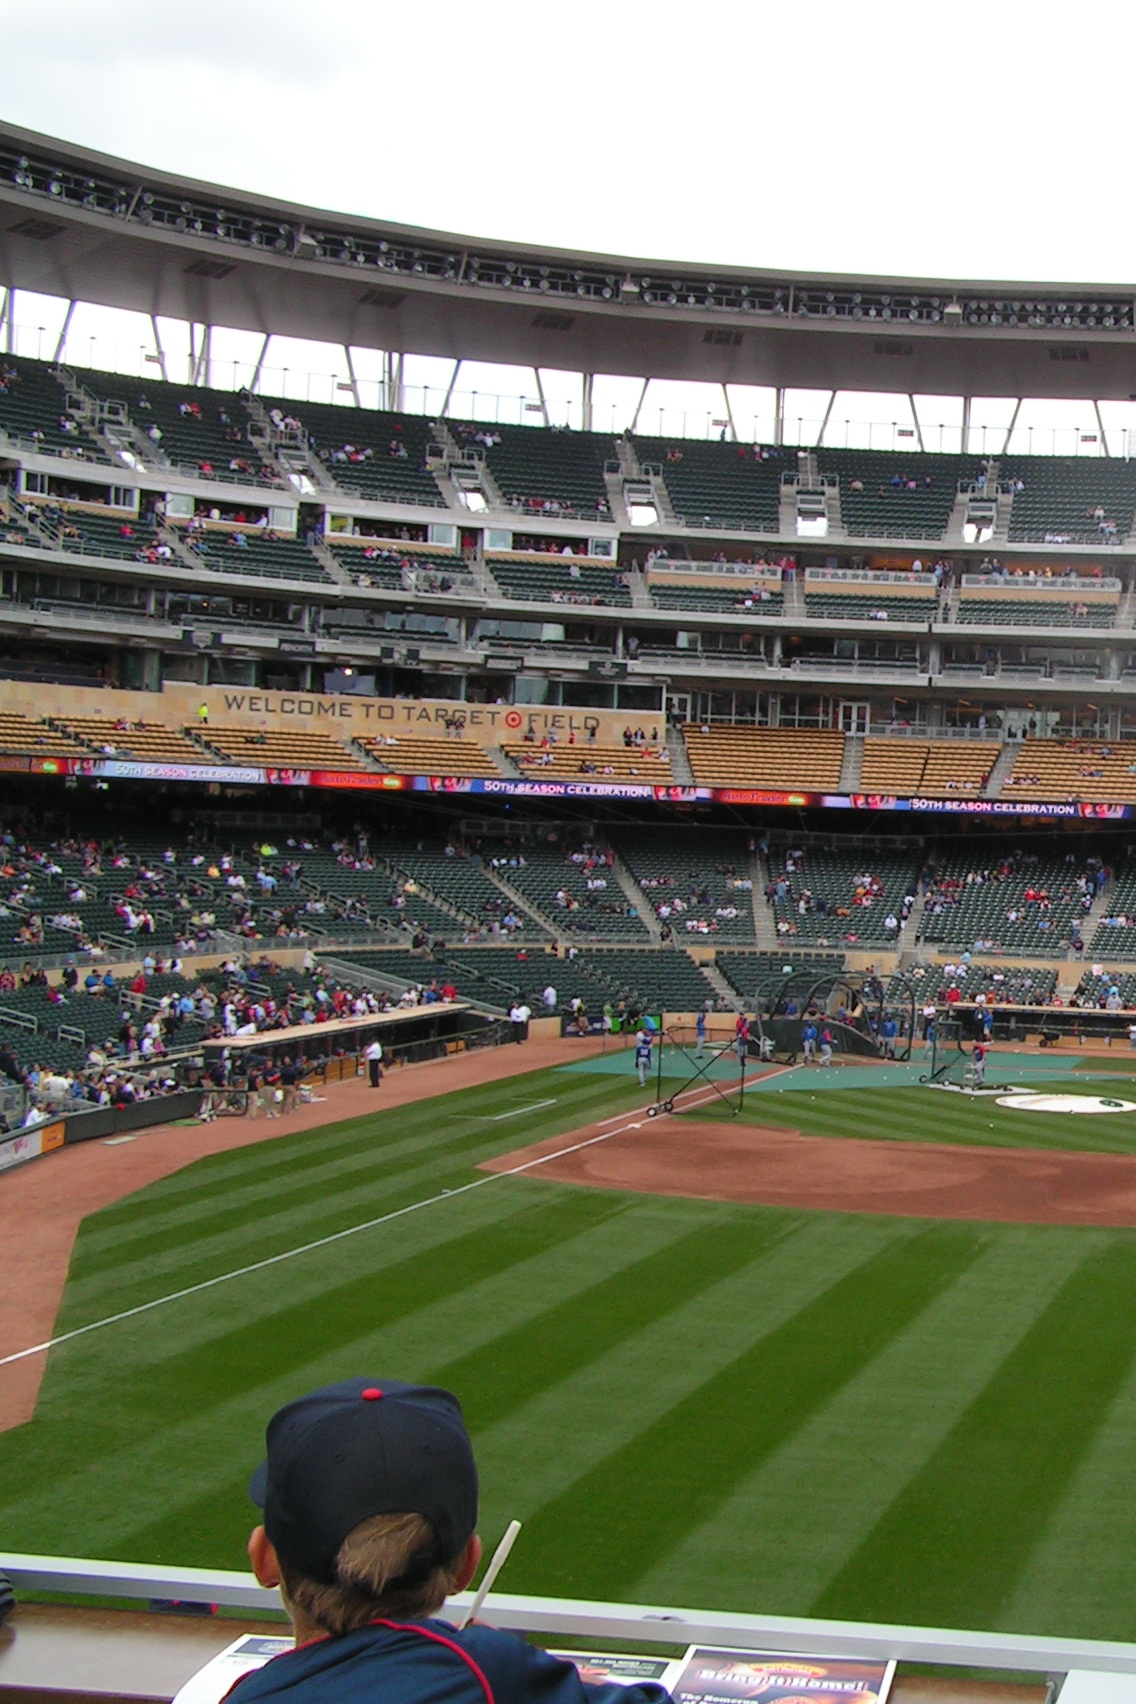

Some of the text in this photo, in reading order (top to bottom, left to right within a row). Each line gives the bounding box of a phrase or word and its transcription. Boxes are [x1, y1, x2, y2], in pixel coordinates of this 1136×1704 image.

[224, 694, 600, 731] WELCOME TO TARGET FIELD
[116, 764, 260, 782] 50TH SEASON CELEBRATION
[484, 780, 650, 798] 50TH SEASON CELEBRATION
[911, 798, 1075, 815] 50TH SEASON CELEBRATION
[700, 1669, 763, 1686] Bring
[680, 1692, 701, 1702] The
